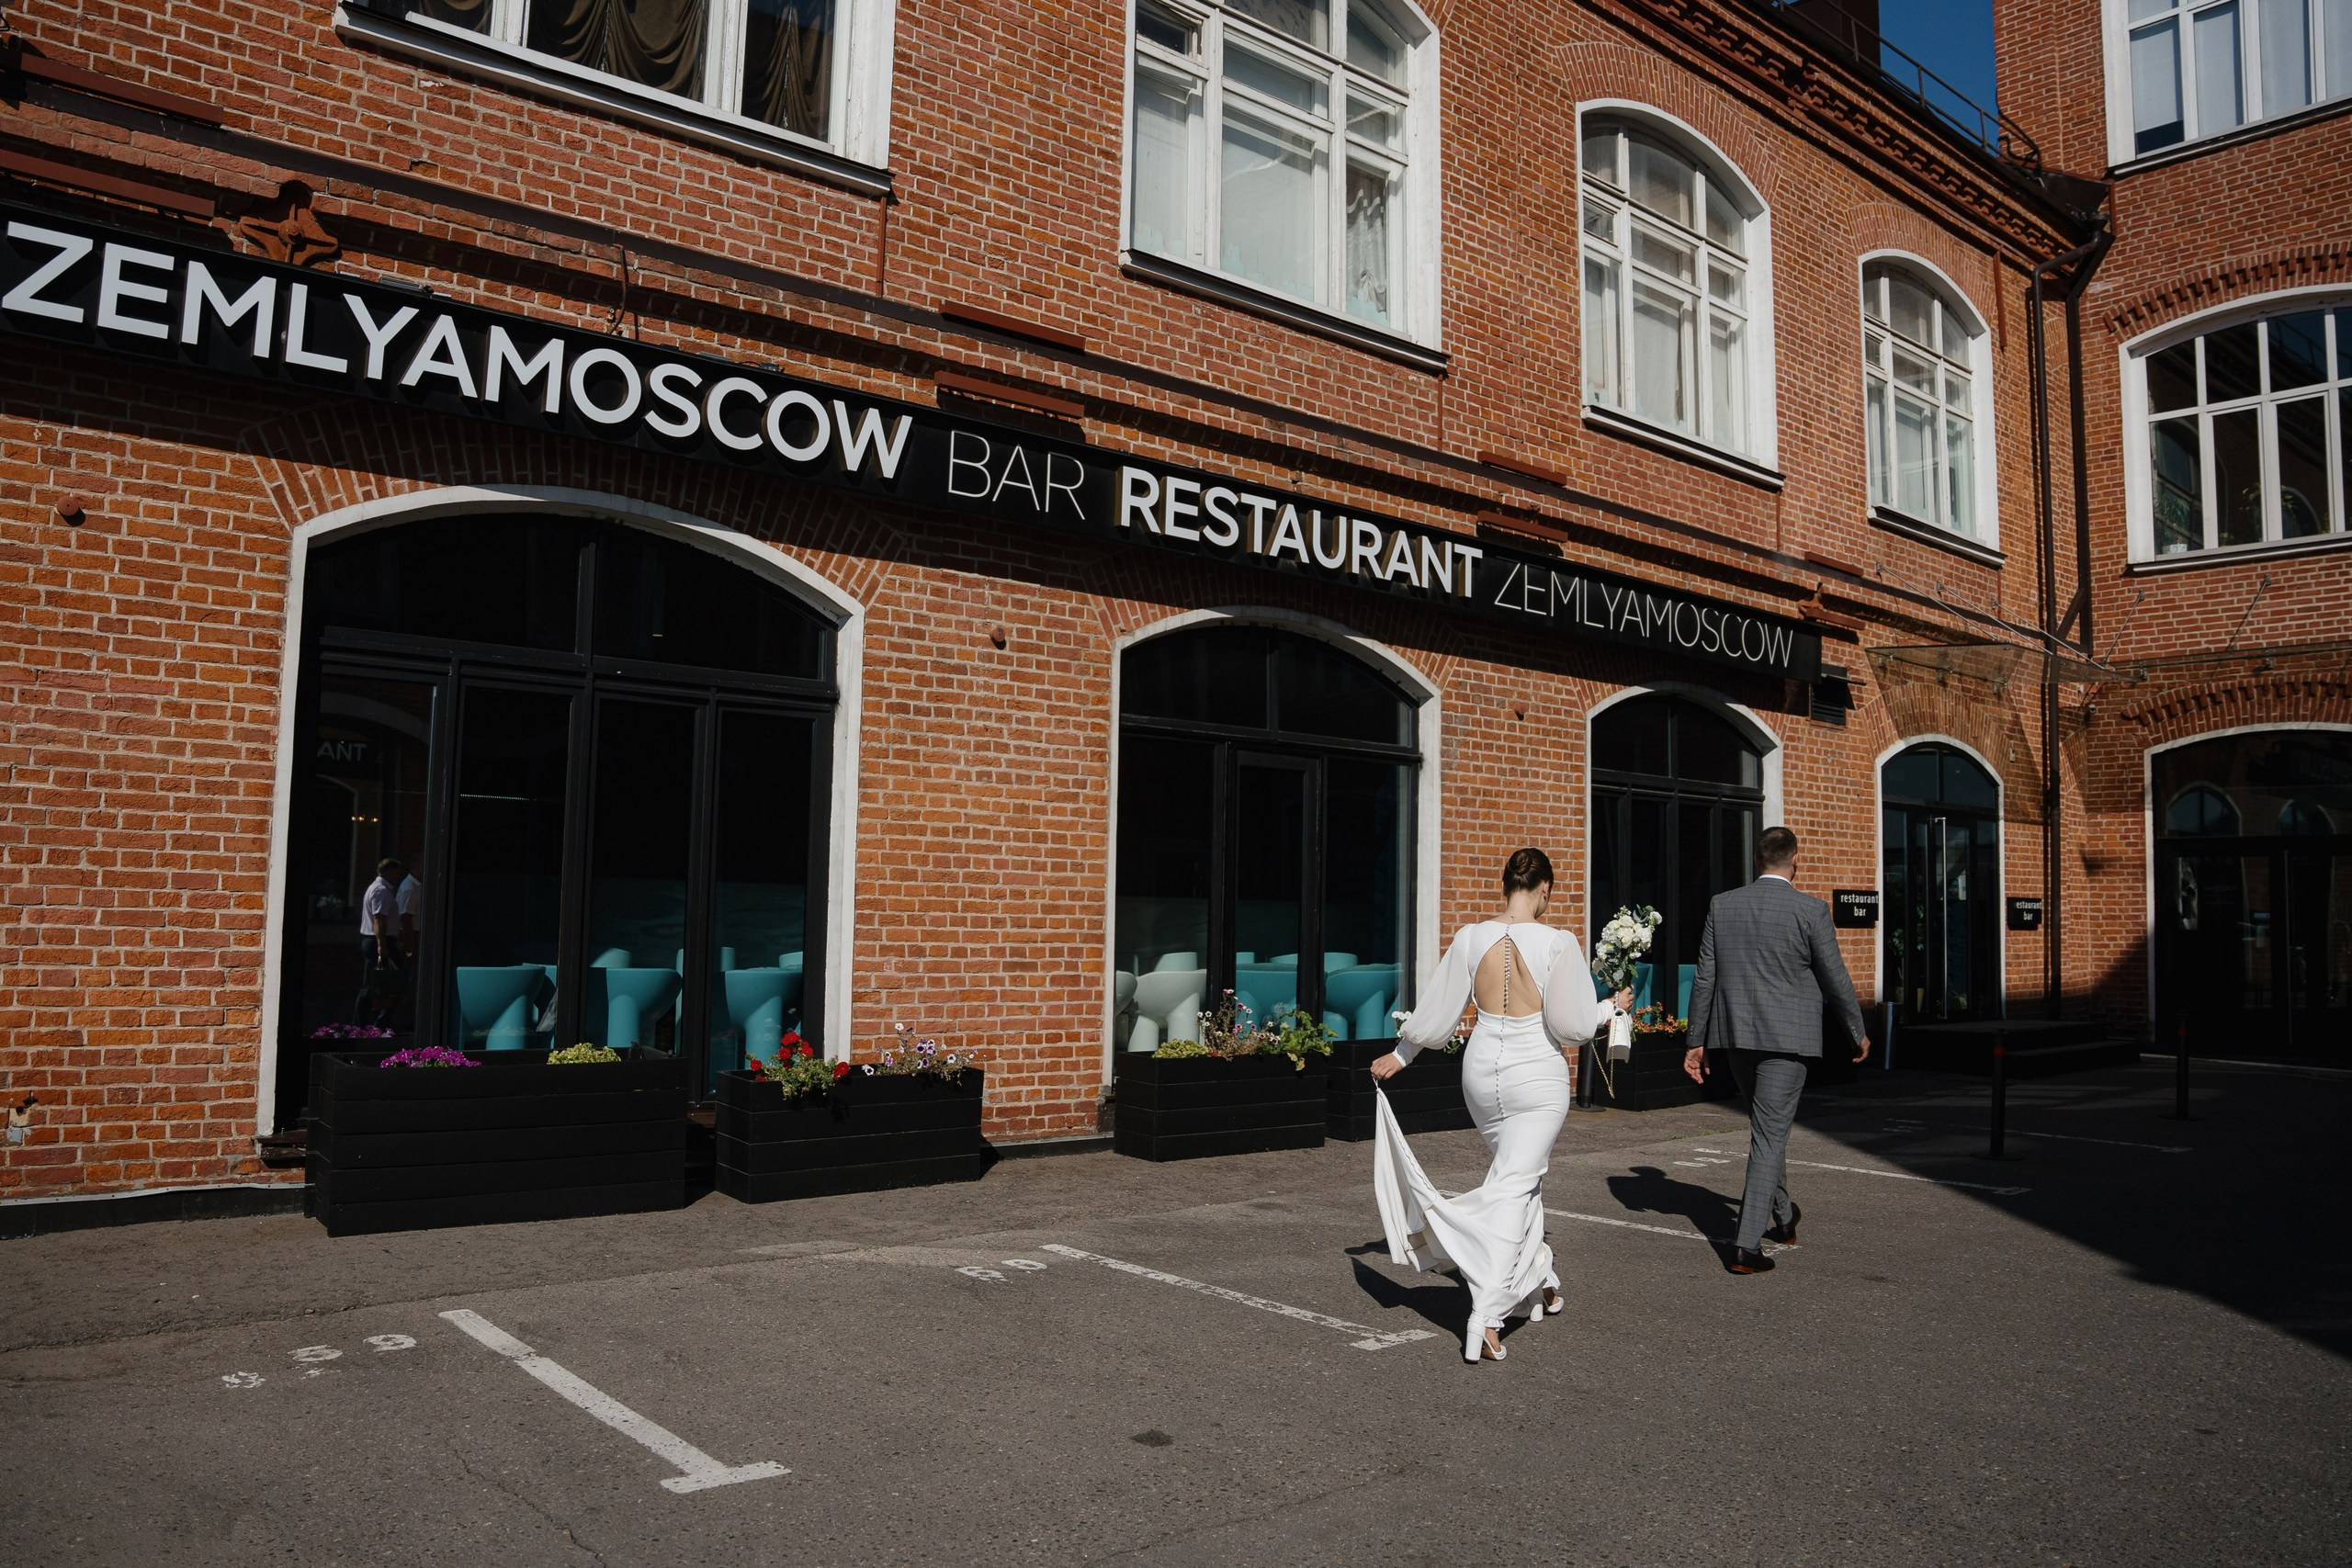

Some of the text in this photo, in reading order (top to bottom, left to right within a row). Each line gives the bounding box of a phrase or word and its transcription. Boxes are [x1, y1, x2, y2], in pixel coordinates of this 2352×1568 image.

[2, 221, 1794, 669] ZEMLYAMOSCOW BAR RESTAURANT ZEMLYAMOSCOW
[1840, 894, 1879, 905] restaurant
[1853, 907, 1867, 917] bar
[2023, 911, 2033, 920] bar
